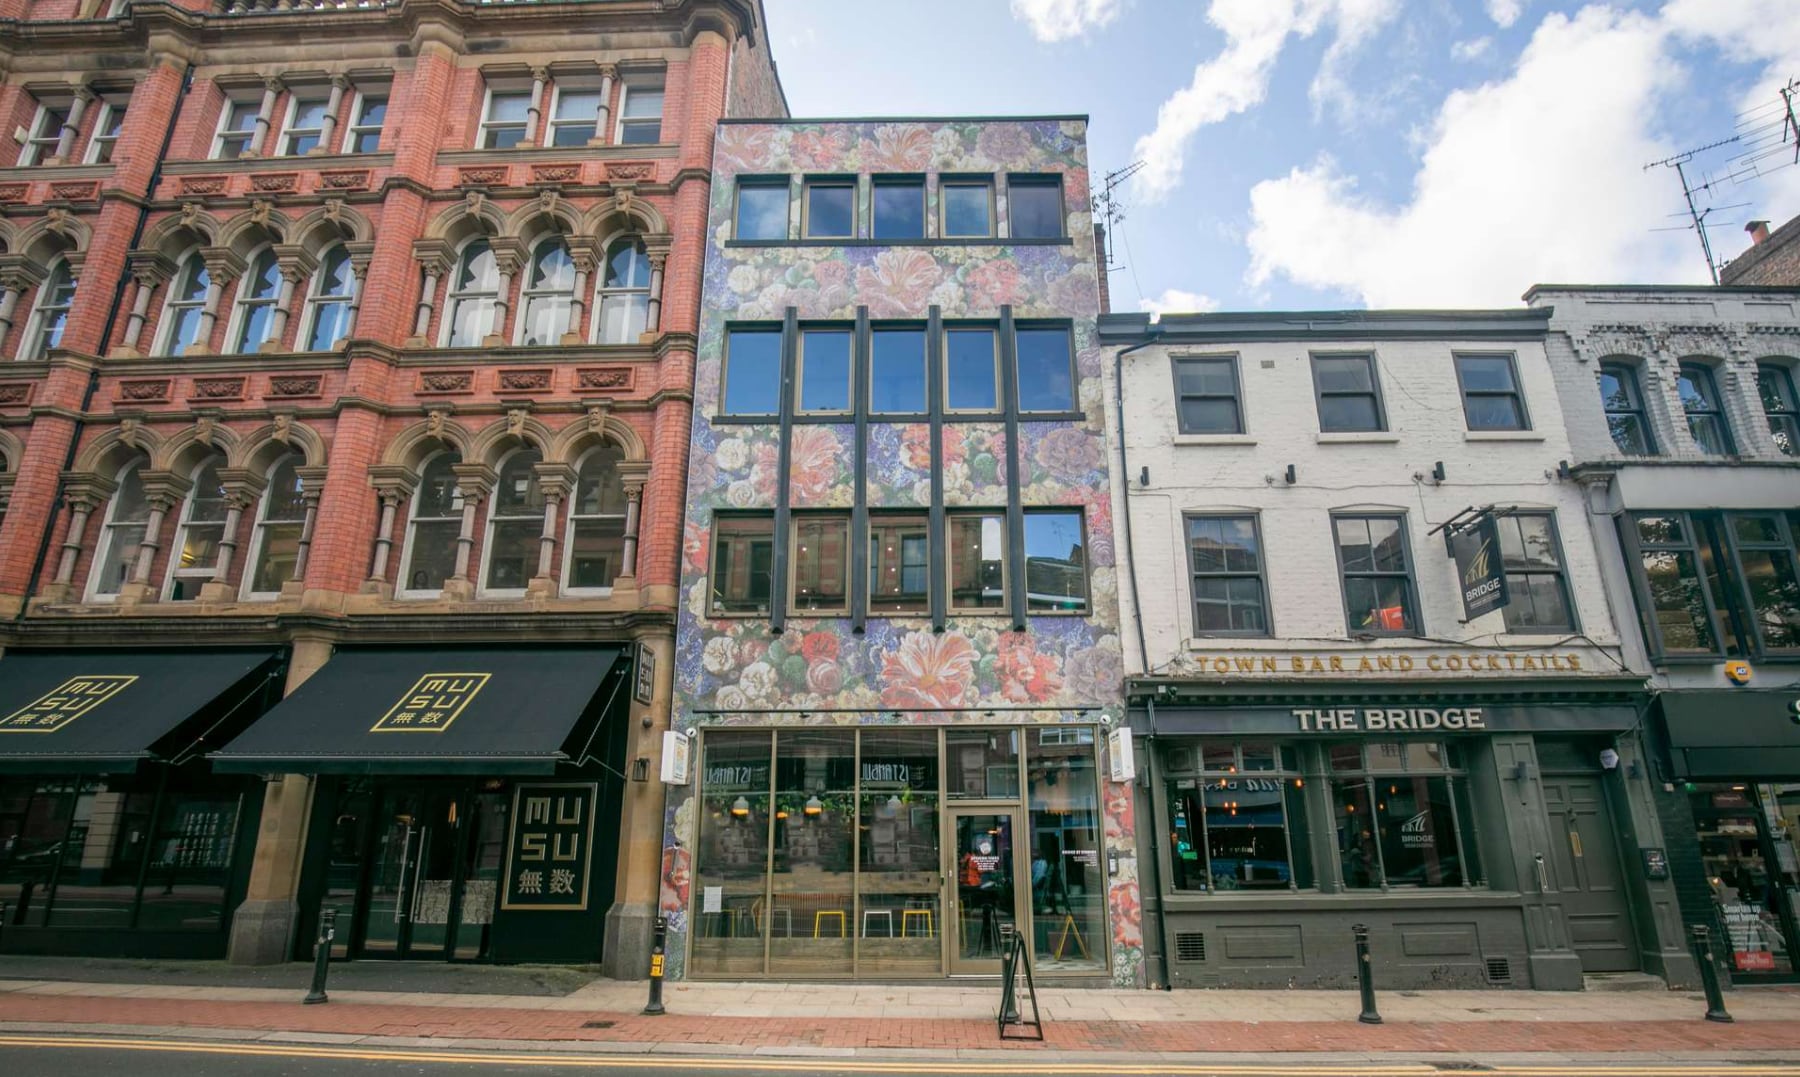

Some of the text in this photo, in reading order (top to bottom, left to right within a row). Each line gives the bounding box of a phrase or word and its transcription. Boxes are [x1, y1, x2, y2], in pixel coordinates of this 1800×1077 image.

[1465, 577, 1501, 601] BRIDGE
[1196, 653, 1582, 673] TOWN BAR AND COCKTAILS
[33, 697, 94, 710] SU
[405, 695, 460, 708] SU
[1292, 708, 1485, 730] THE BRIDGE
[524, 797, 582, 825] MU
[520, 833, 579, 861] SU
[1401, 835, 1435, 843] BRIDGE
[517, 868, 576, 894] 無数
